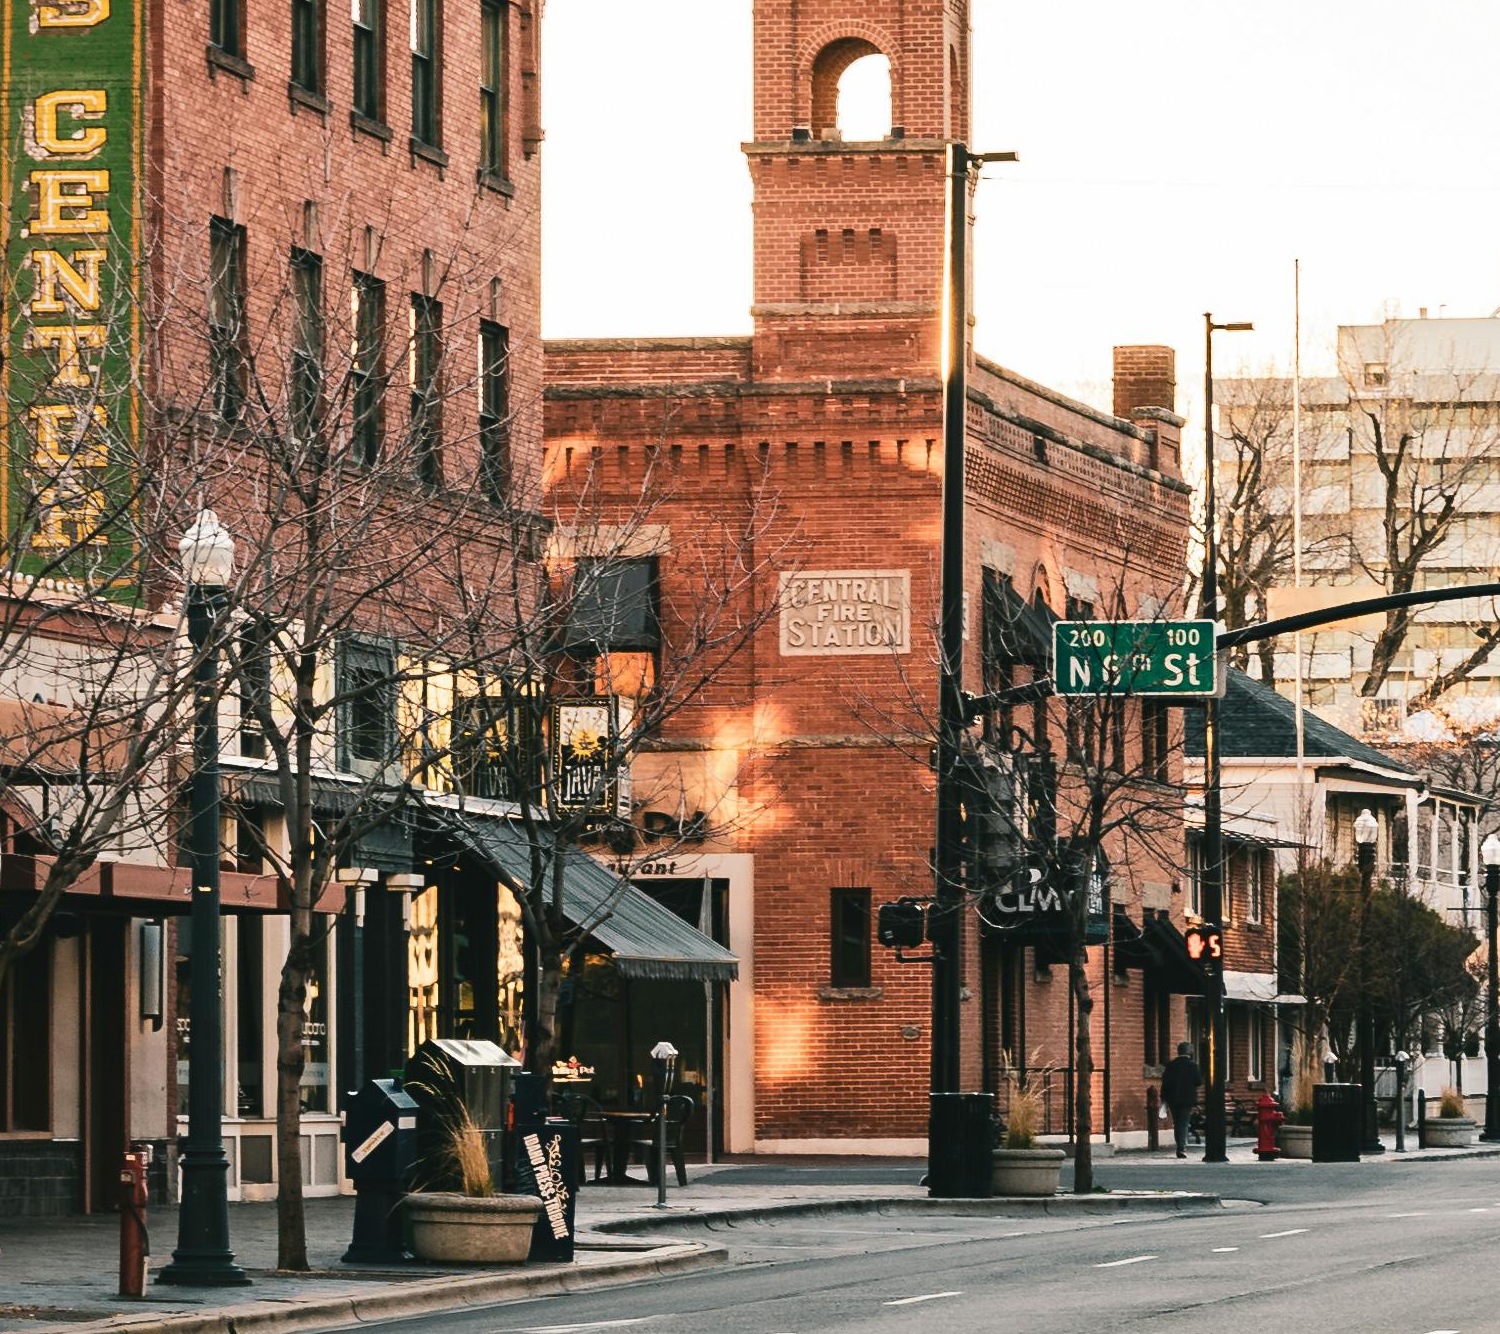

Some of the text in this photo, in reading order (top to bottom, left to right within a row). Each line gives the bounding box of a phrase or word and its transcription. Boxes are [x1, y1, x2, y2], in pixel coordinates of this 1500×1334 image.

[28, 90, 110, 548] CENTER
[790, 578, 899, 610] CENTRAL
[817, 603, 873, 623] FIRE
[787, 615, 903, 647] STATION
[1069, 628, 1200, 648] 200 100
[1069, 655, 1091, 687] N
[1163, 652, 1201, 687] St
[1208, 934, 1221, 957] 5
[523, 1133, 546, 1166] IDAHO
